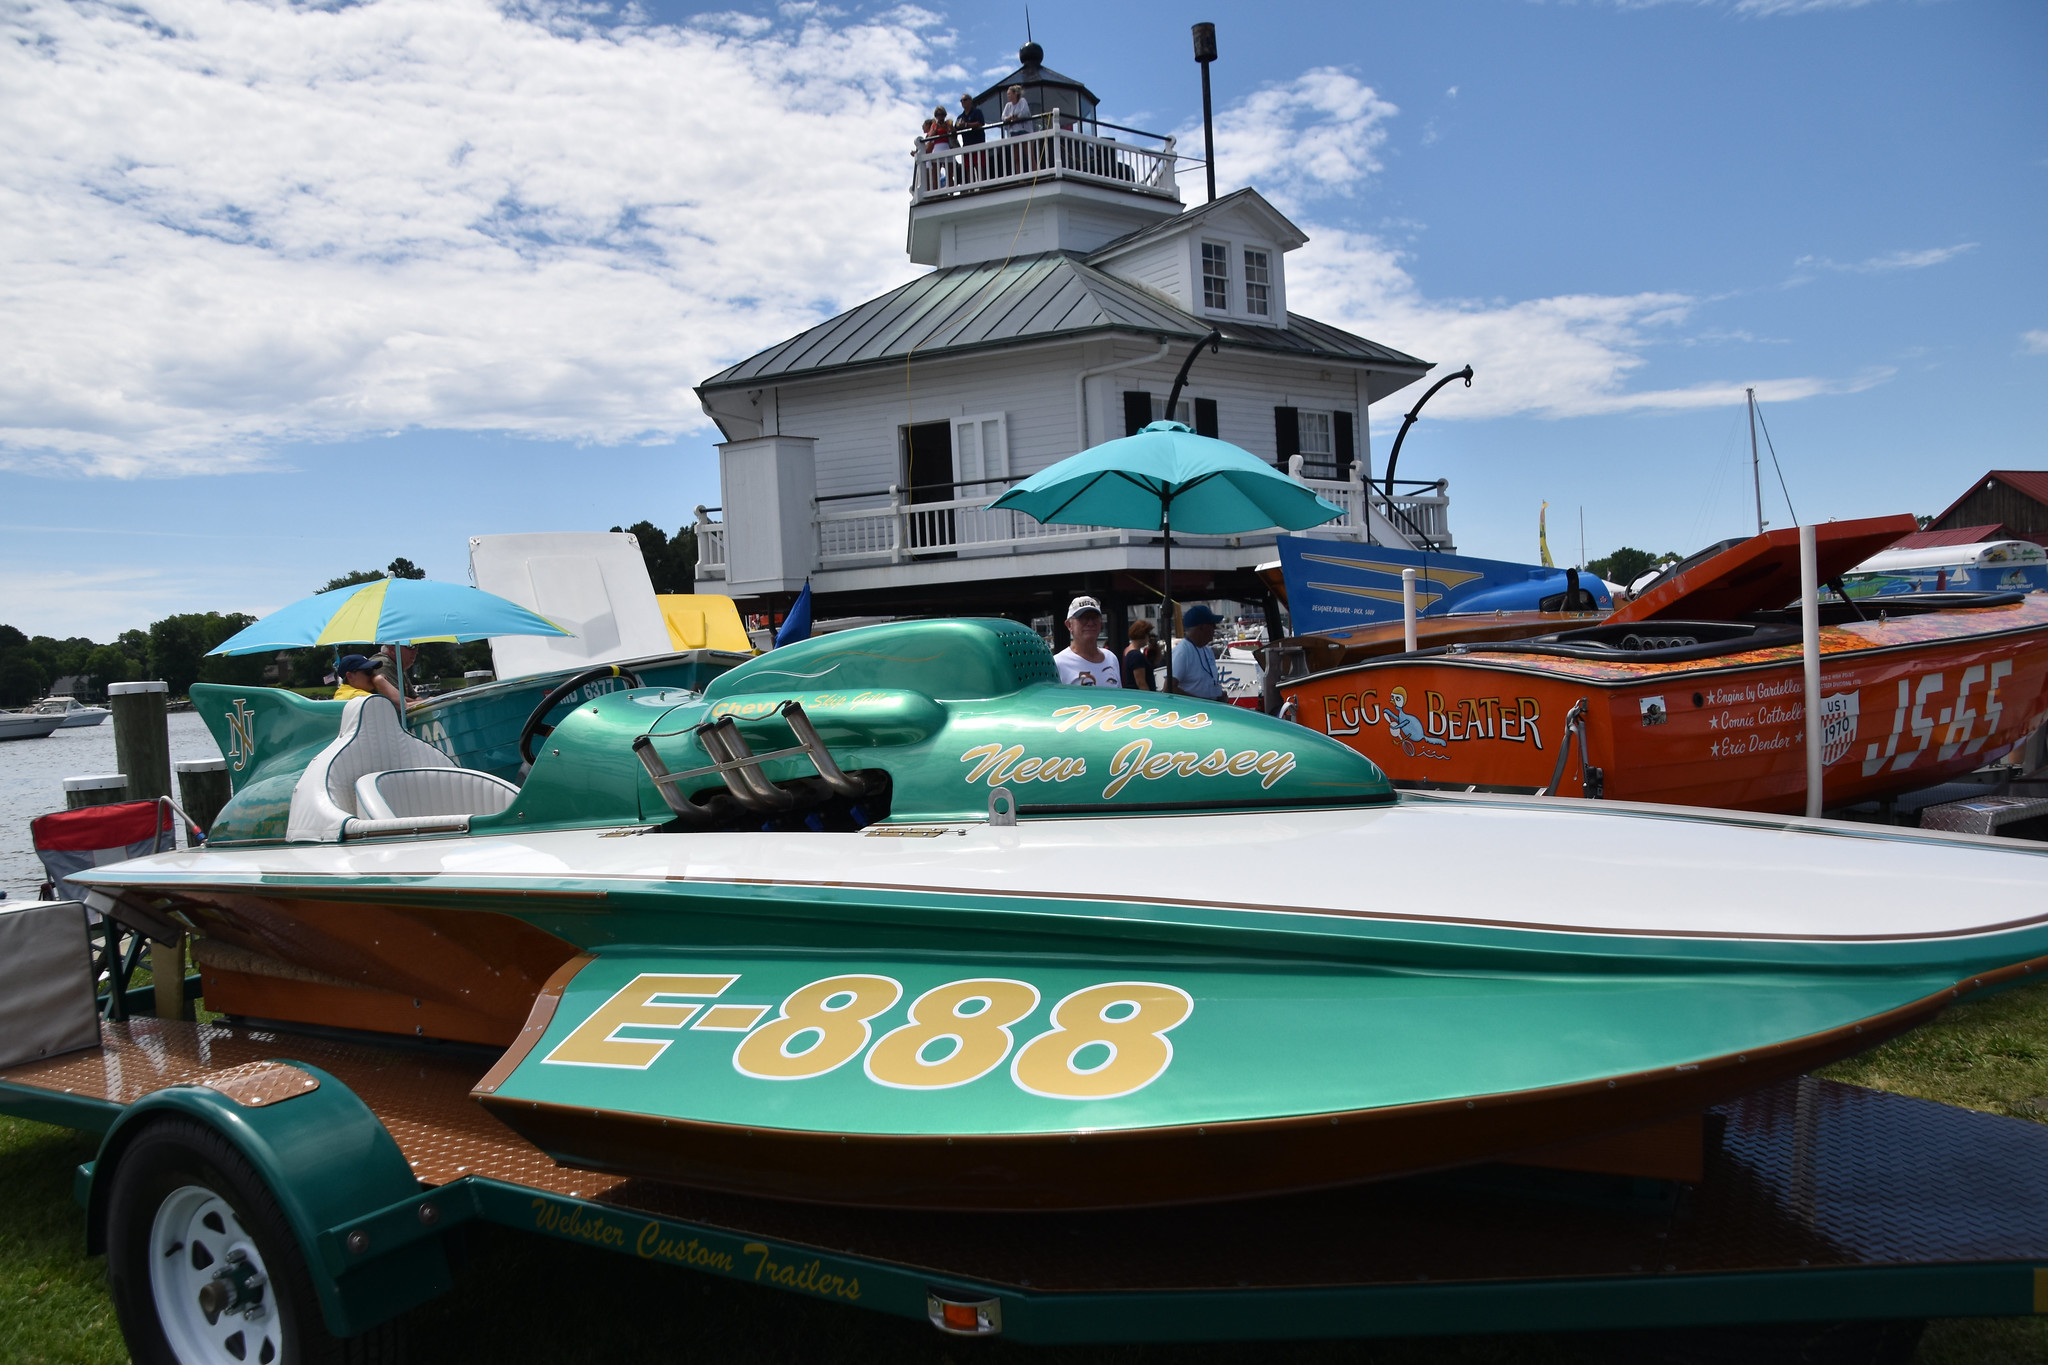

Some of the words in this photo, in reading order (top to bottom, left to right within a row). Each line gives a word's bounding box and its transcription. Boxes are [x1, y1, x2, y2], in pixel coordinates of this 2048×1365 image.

[583, 679, 615, 700] 6377
[1716, 688, 1745, 706] Engine
[1746, 687, 1755, 702] by
[1757, 679, 1803, 699] Gardella
[1052, 704, 1213, 733] Miss
[1323, 689, 1381, 737] EGG
[1426, 690, 1544, 750] BEATER
[1721, 711, 1755, 730] Connie
[1827, 700, 1841, 713] US
[1862, 659, 2013, 778] JS-65
[1721, 737, 1746, 756] Eric
[1749, 731, 1791, 752] Dender
[1824, 716, 1850, 744] 1970
[960, 743, 1087, 787] New
[1102, 738, 1297, 800] Jersey
[540, 972, 1195, 1100] E-888
[532, 1198, 626, 1247] Webster
[637, 1221, 735, 1273] Custom
[744, 1242, 863, 1301] Trailers
